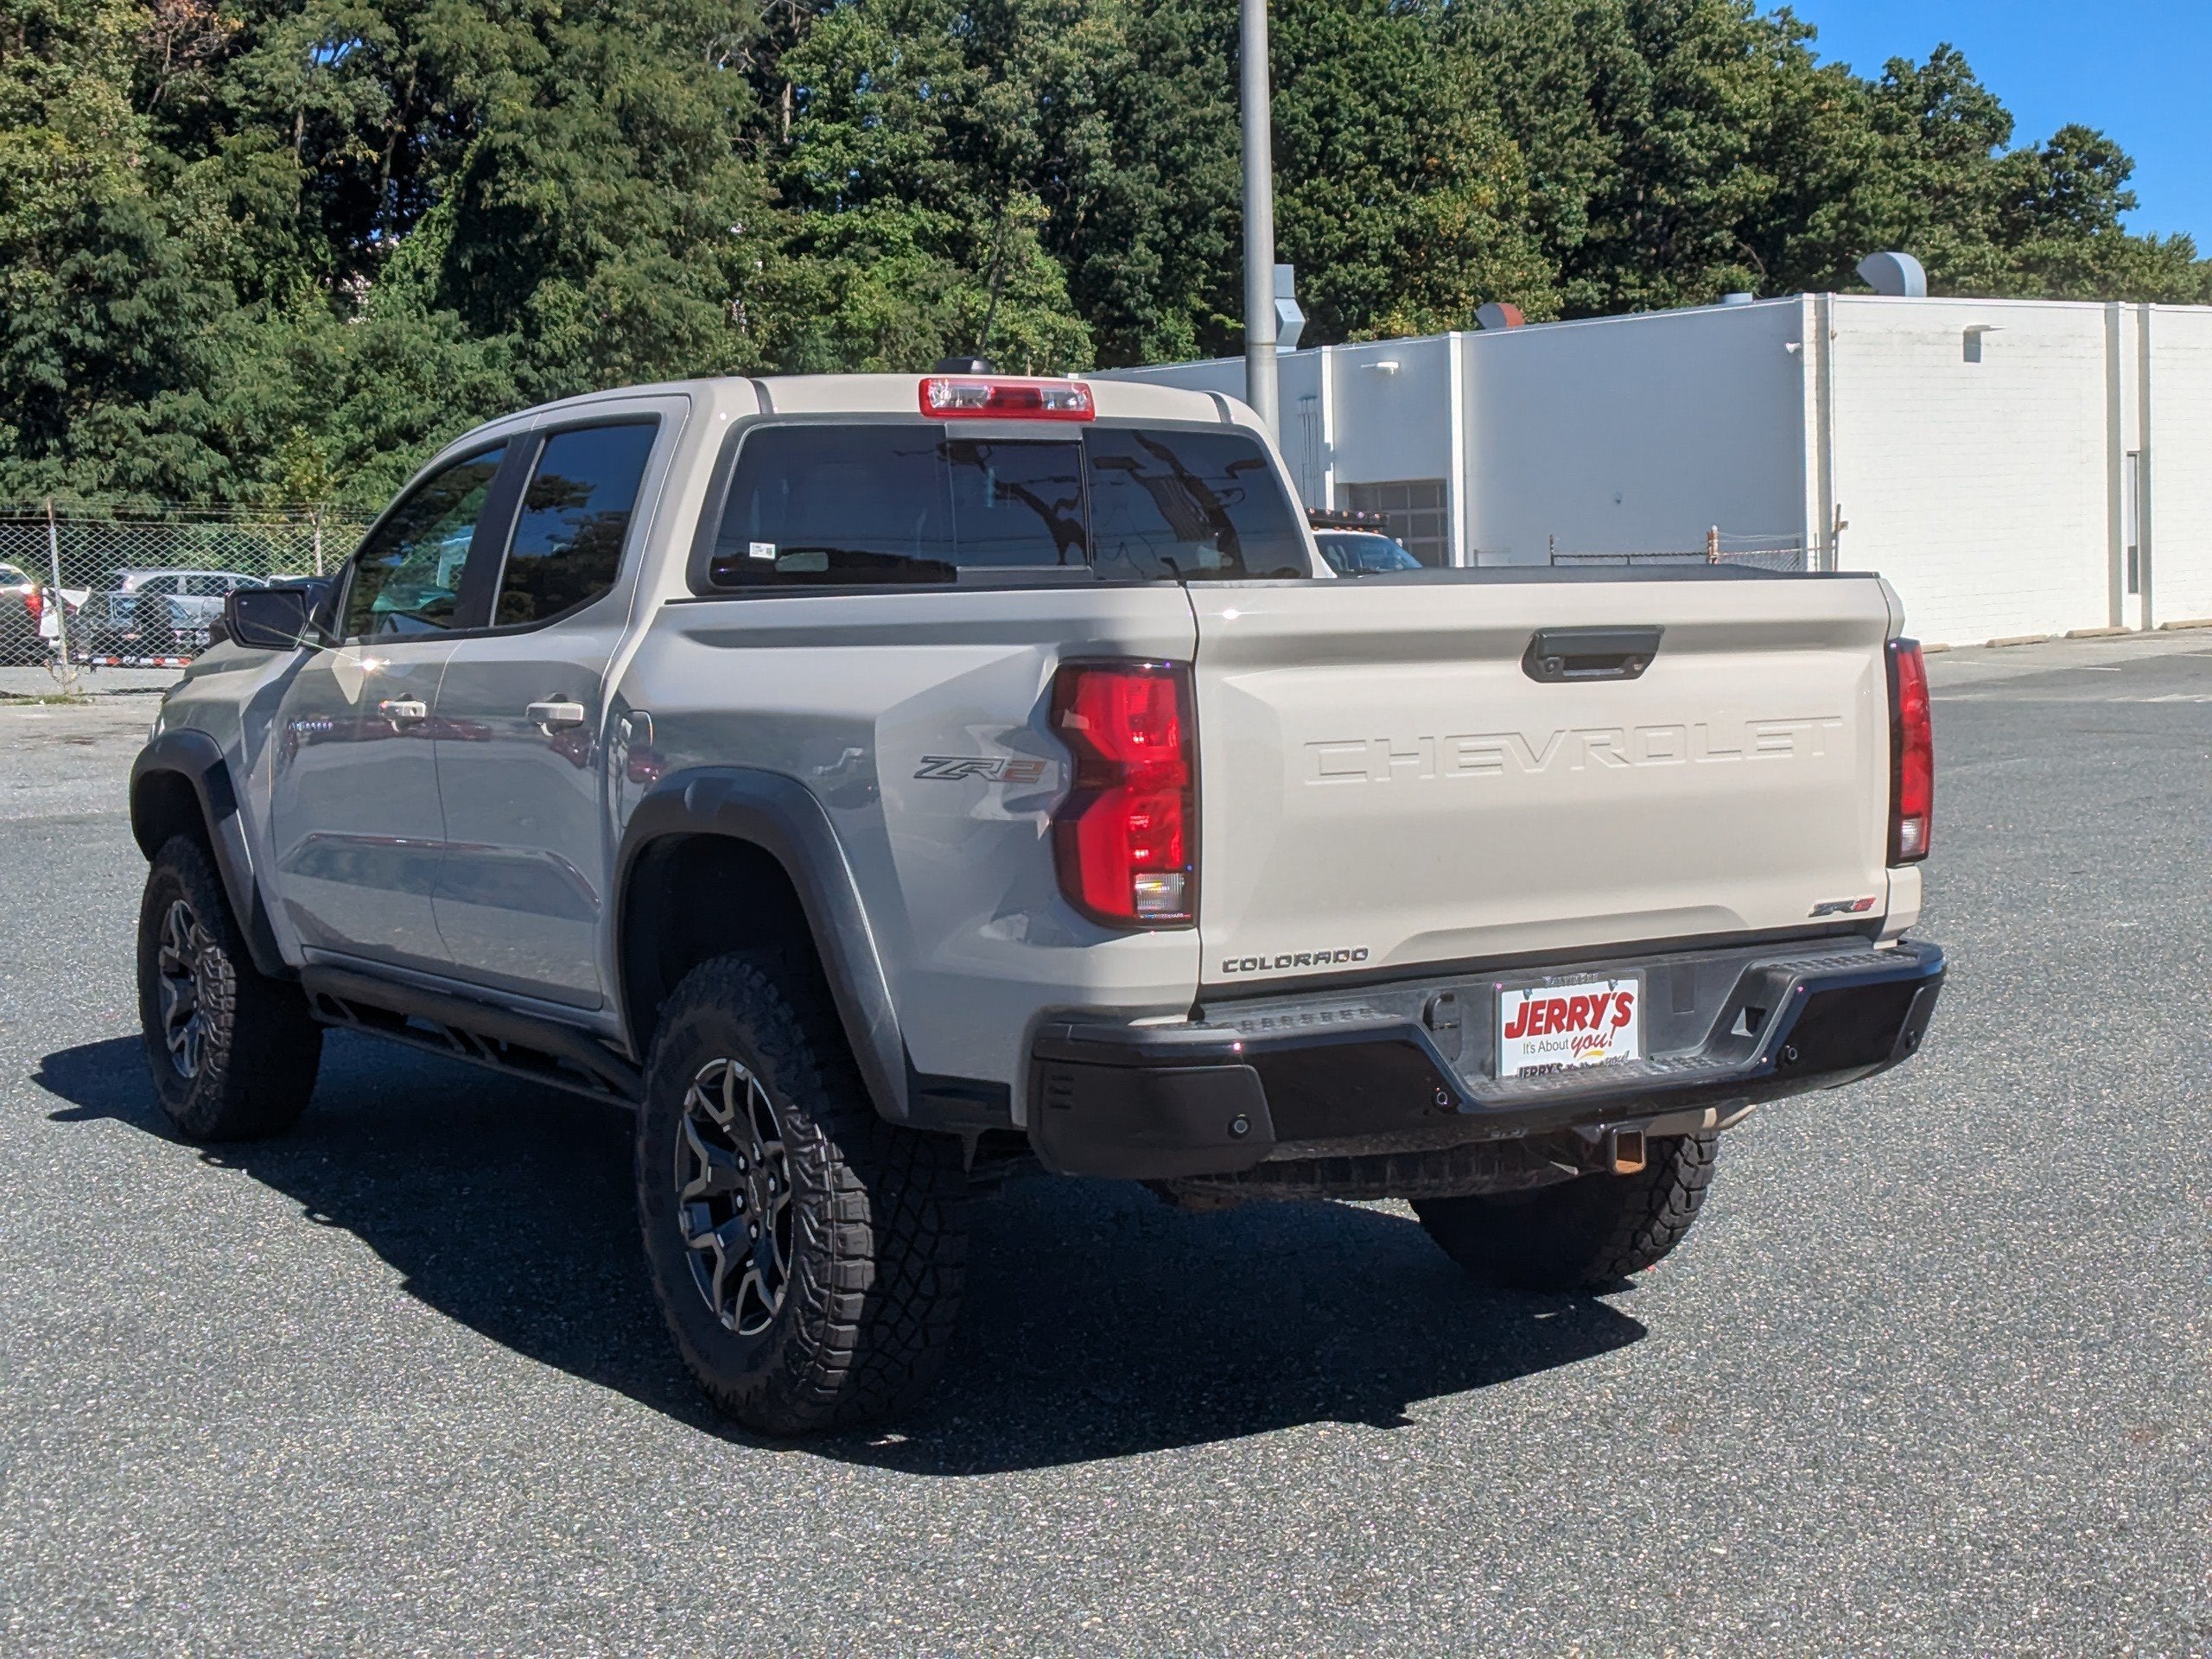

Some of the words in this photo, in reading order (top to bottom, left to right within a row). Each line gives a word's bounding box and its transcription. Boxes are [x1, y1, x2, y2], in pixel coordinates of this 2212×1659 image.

[1304, 716, 1841, 785] CHEVROLET
[913, 755, 1046, 784] ZR2
[1221, 945, 1370, 974] COLORADO
[1504, 991, 1634, 1039] JERRY'S
[1522, 1042, 1536, 1054] It's
[1537, 1039, 1569, 1053] About
[1570, 1025, 1616, 1058] you!
